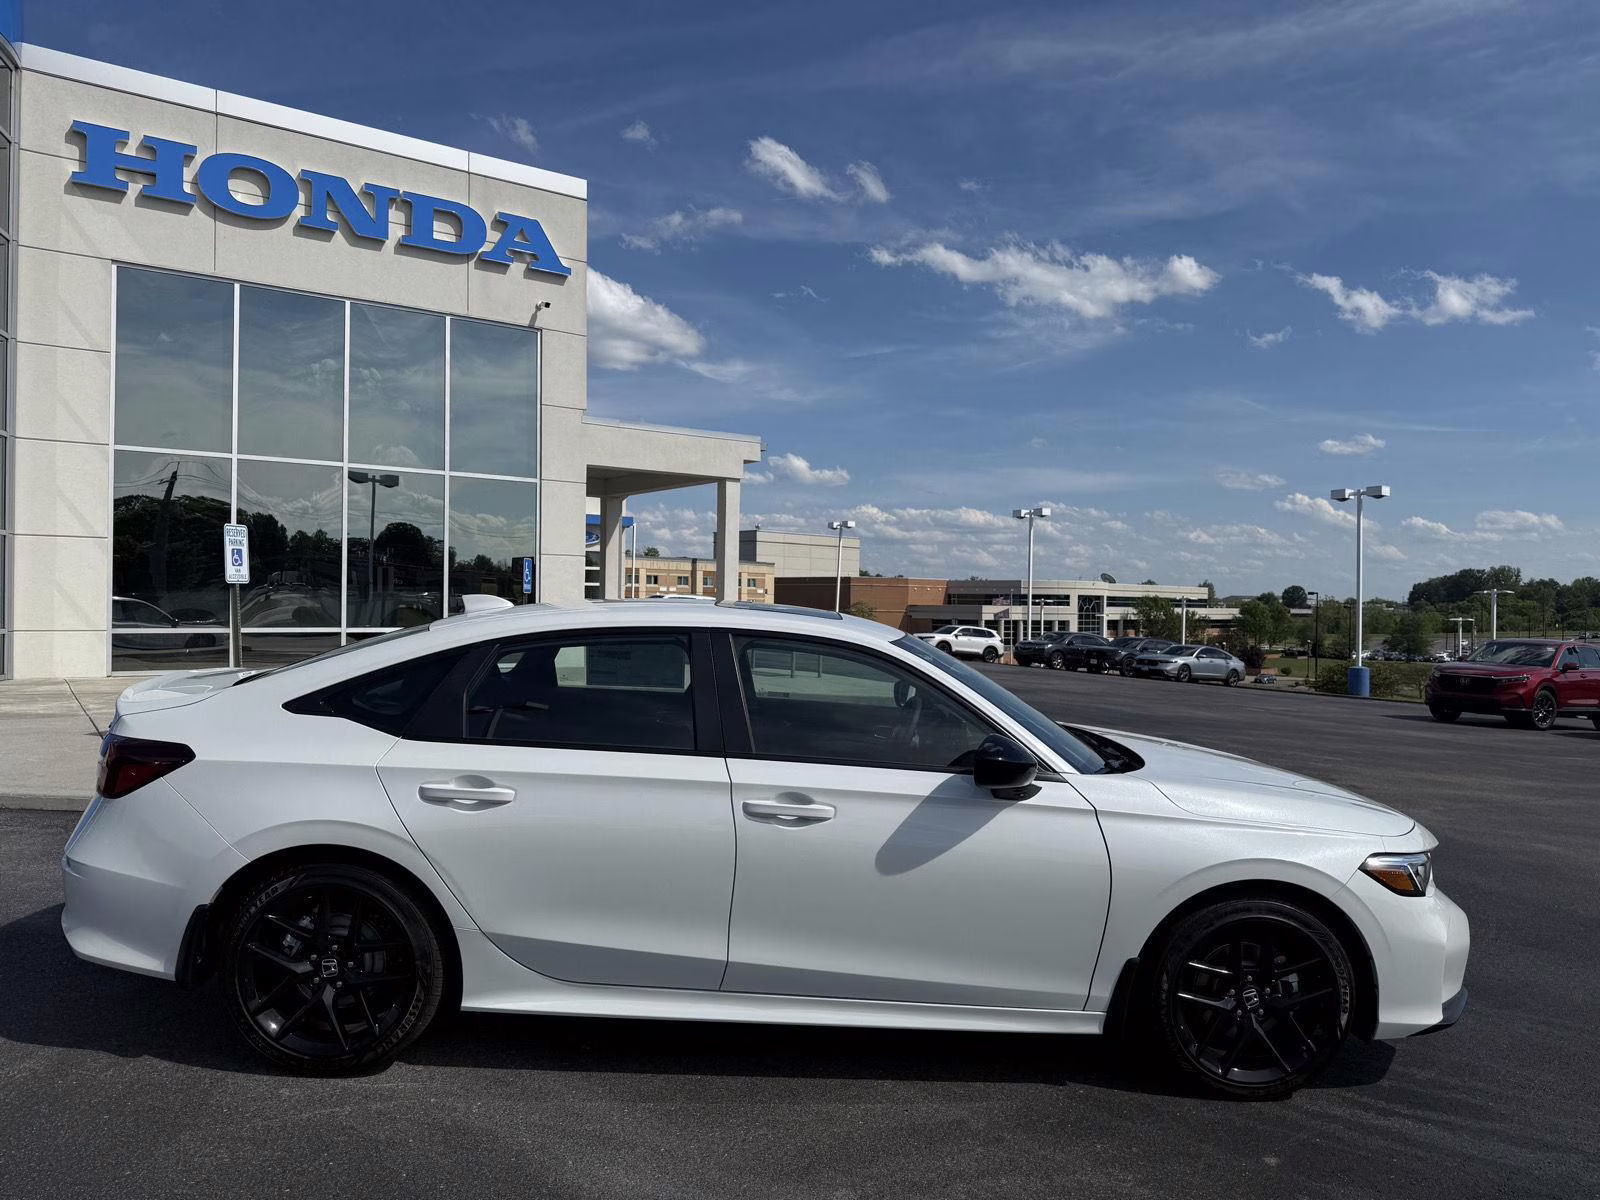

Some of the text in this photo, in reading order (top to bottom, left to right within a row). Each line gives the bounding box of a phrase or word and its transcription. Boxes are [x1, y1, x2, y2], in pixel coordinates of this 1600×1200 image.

[71, 119, 572, 276] HONDA
[226, 528, 245, 538] RESERVED
[228, 538, 244, 546] PARKING
